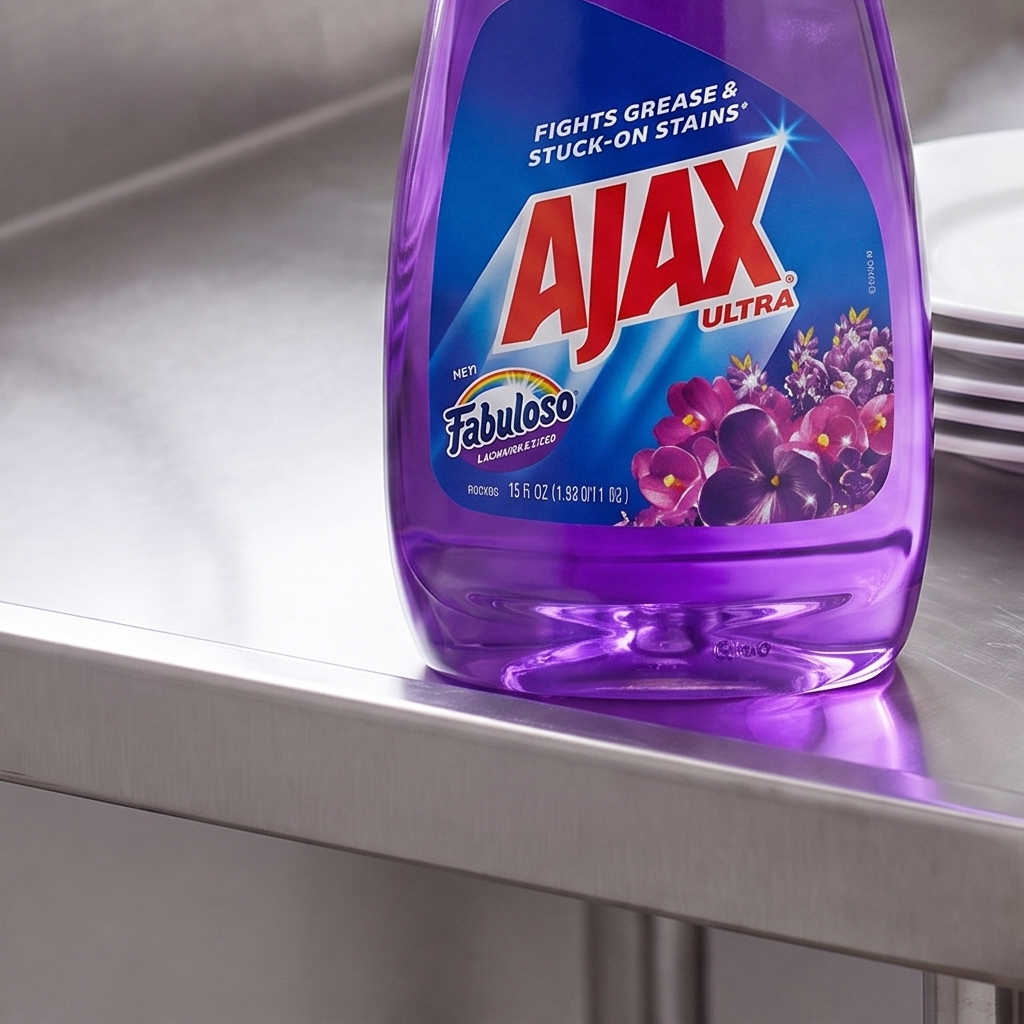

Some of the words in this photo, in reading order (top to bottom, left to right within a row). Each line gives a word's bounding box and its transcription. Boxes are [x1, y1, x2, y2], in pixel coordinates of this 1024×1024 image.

[533, 109, 618, 143] FIGHTS
[622, 84, 718, 122] GREASE
[721, 80, 738, 100] &
[527, 126, 649, 167] STUCK-ON
[500, 145, 783, 366] AJAX
[702, 288, 795, 329] ULTRA
[444, 390, 575, 457] Fabuloso
